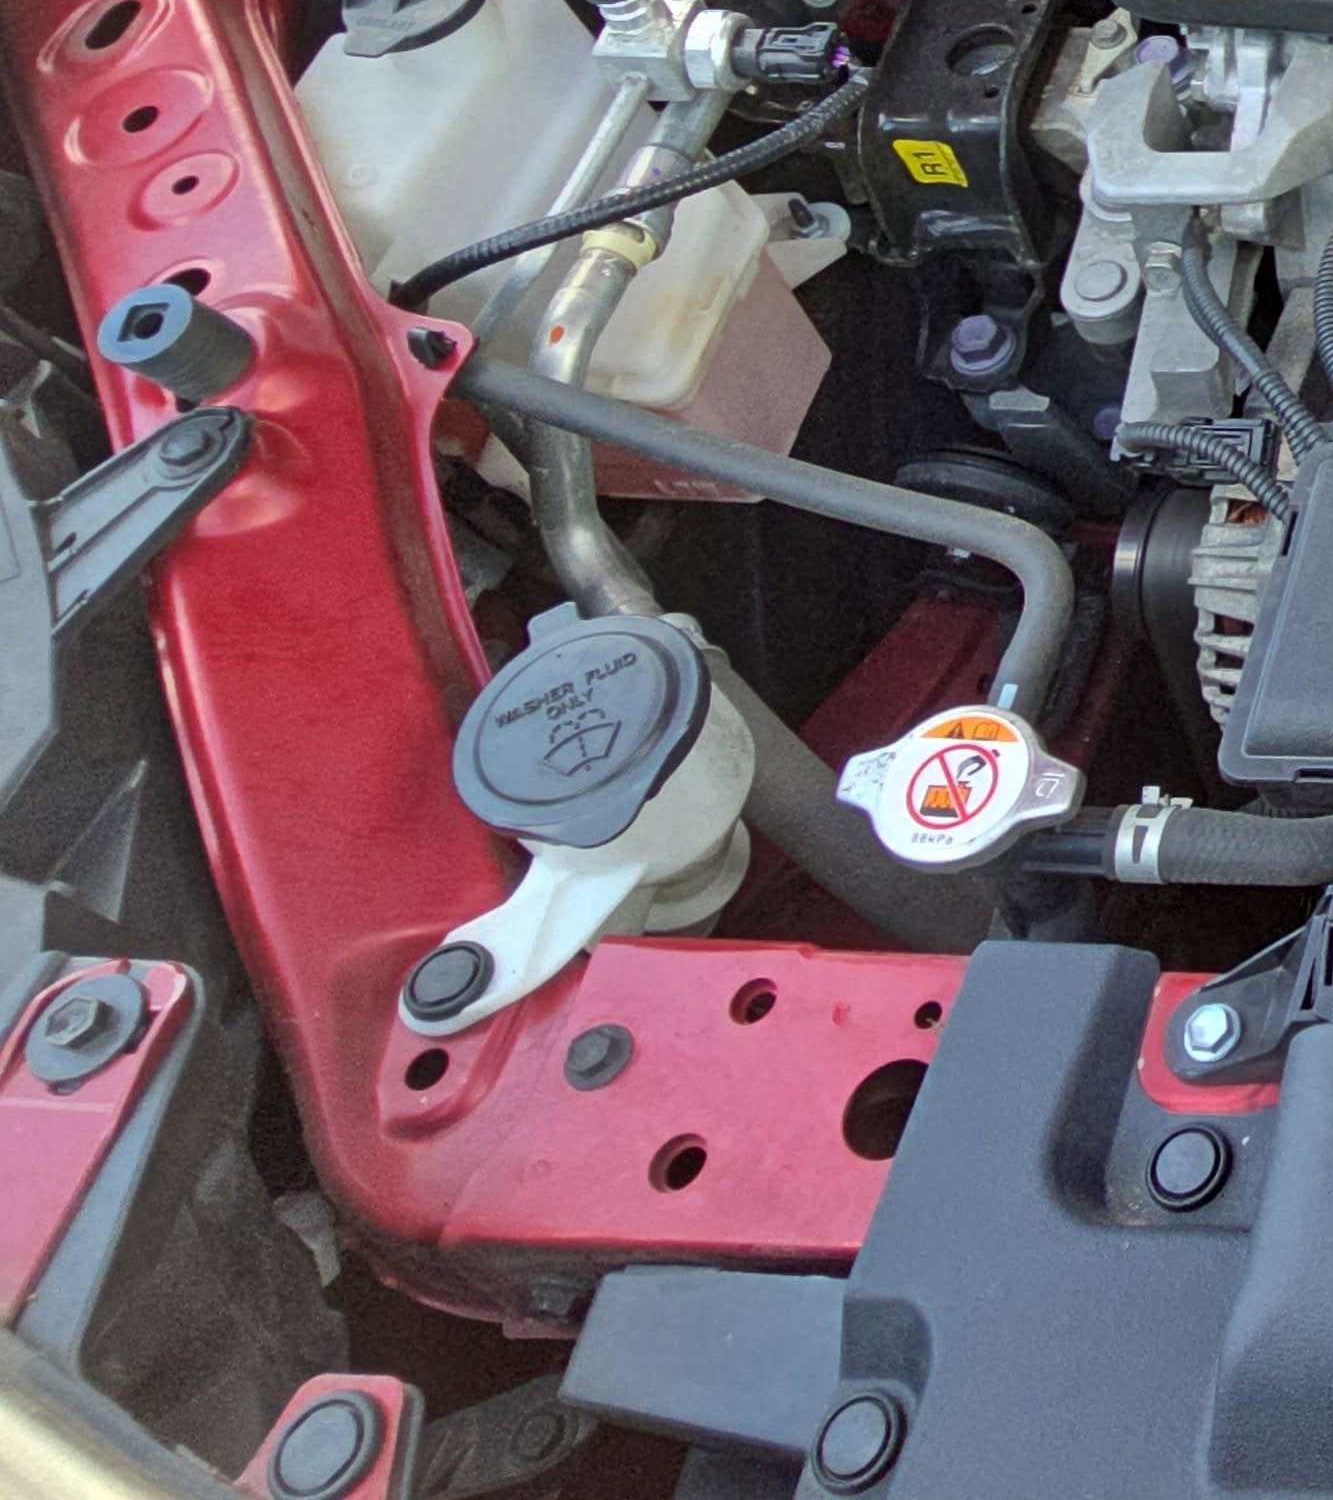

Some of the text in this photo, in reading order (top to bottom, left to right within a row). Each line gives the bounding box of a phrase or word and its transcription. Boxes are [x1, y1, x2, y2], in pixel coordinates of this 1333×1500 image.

[912, 151, 947, 176] R1
[495, 652, 638, 728] WASHER FLUID
[546, 687, 594, 720] ONLY
